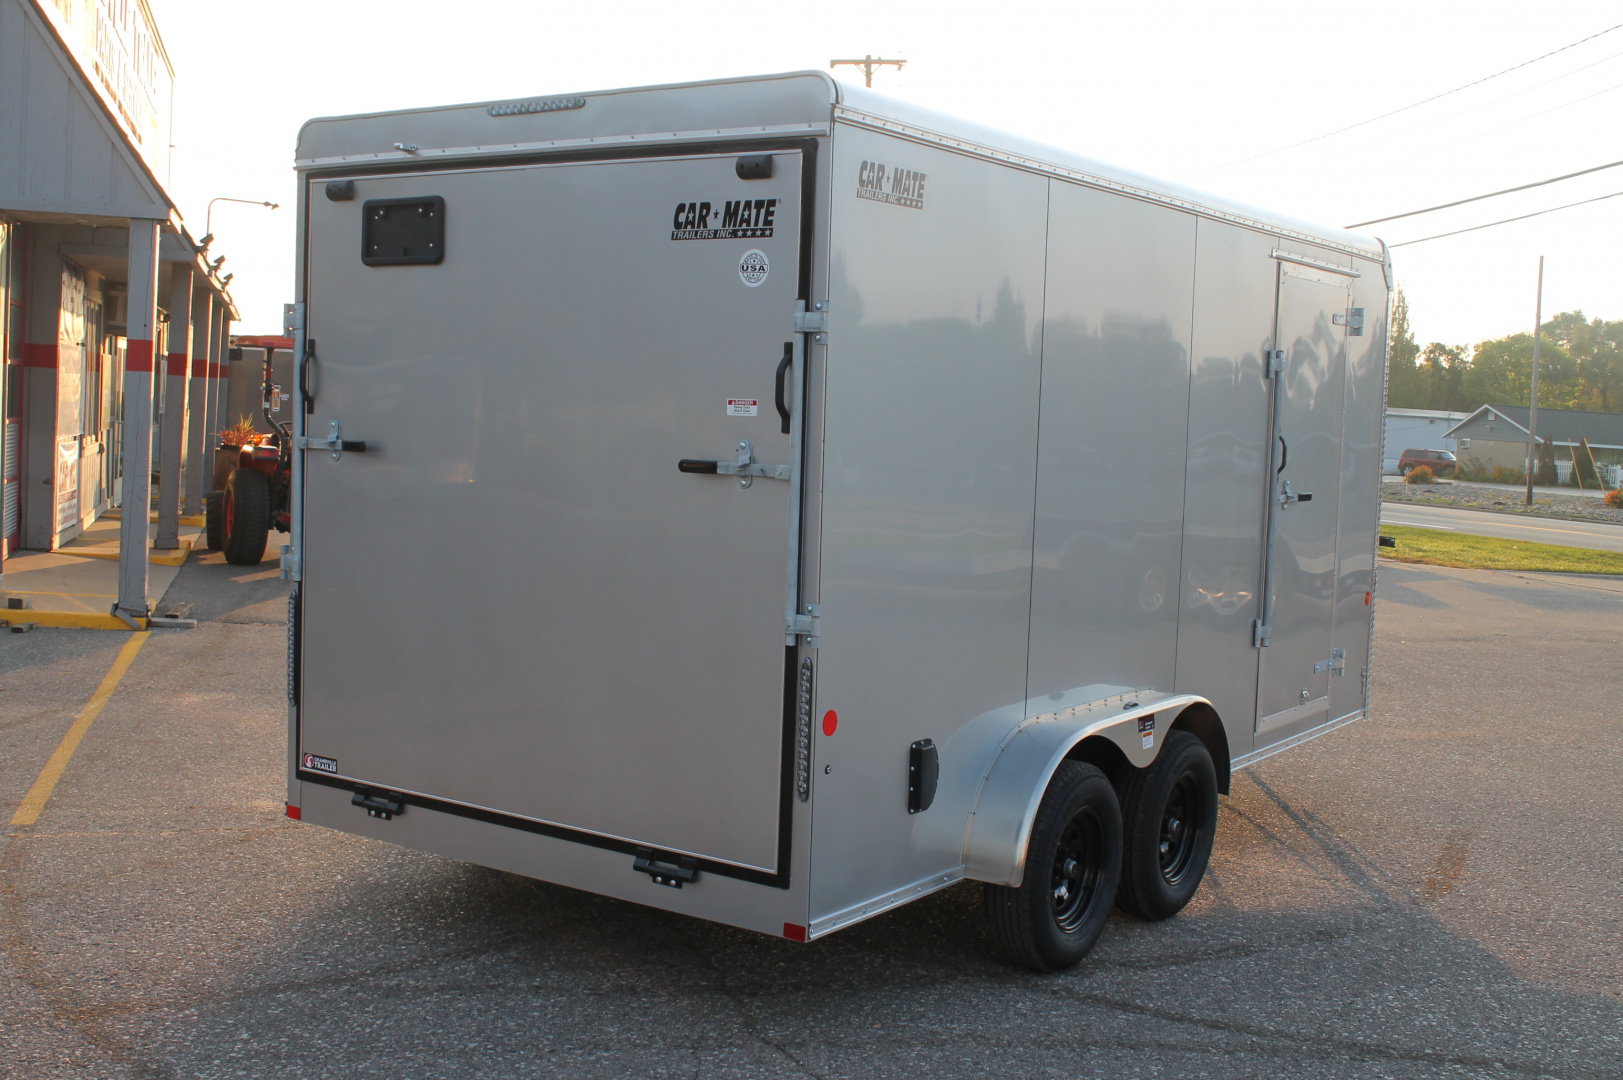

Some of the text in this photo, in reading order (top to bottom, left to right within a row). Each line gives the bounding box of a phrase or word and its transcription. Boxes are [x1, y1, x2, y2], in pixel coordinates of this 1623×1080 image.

[858, 159, 926, 199] CAR MATE
[857, 188, 900, 205] TRAILERS INC.
[673, 198, 777, 231] CAR MATE
[673, 229, 735, 240] TRAILERS INC.
[314, 761, 337, 772] TRAILER
